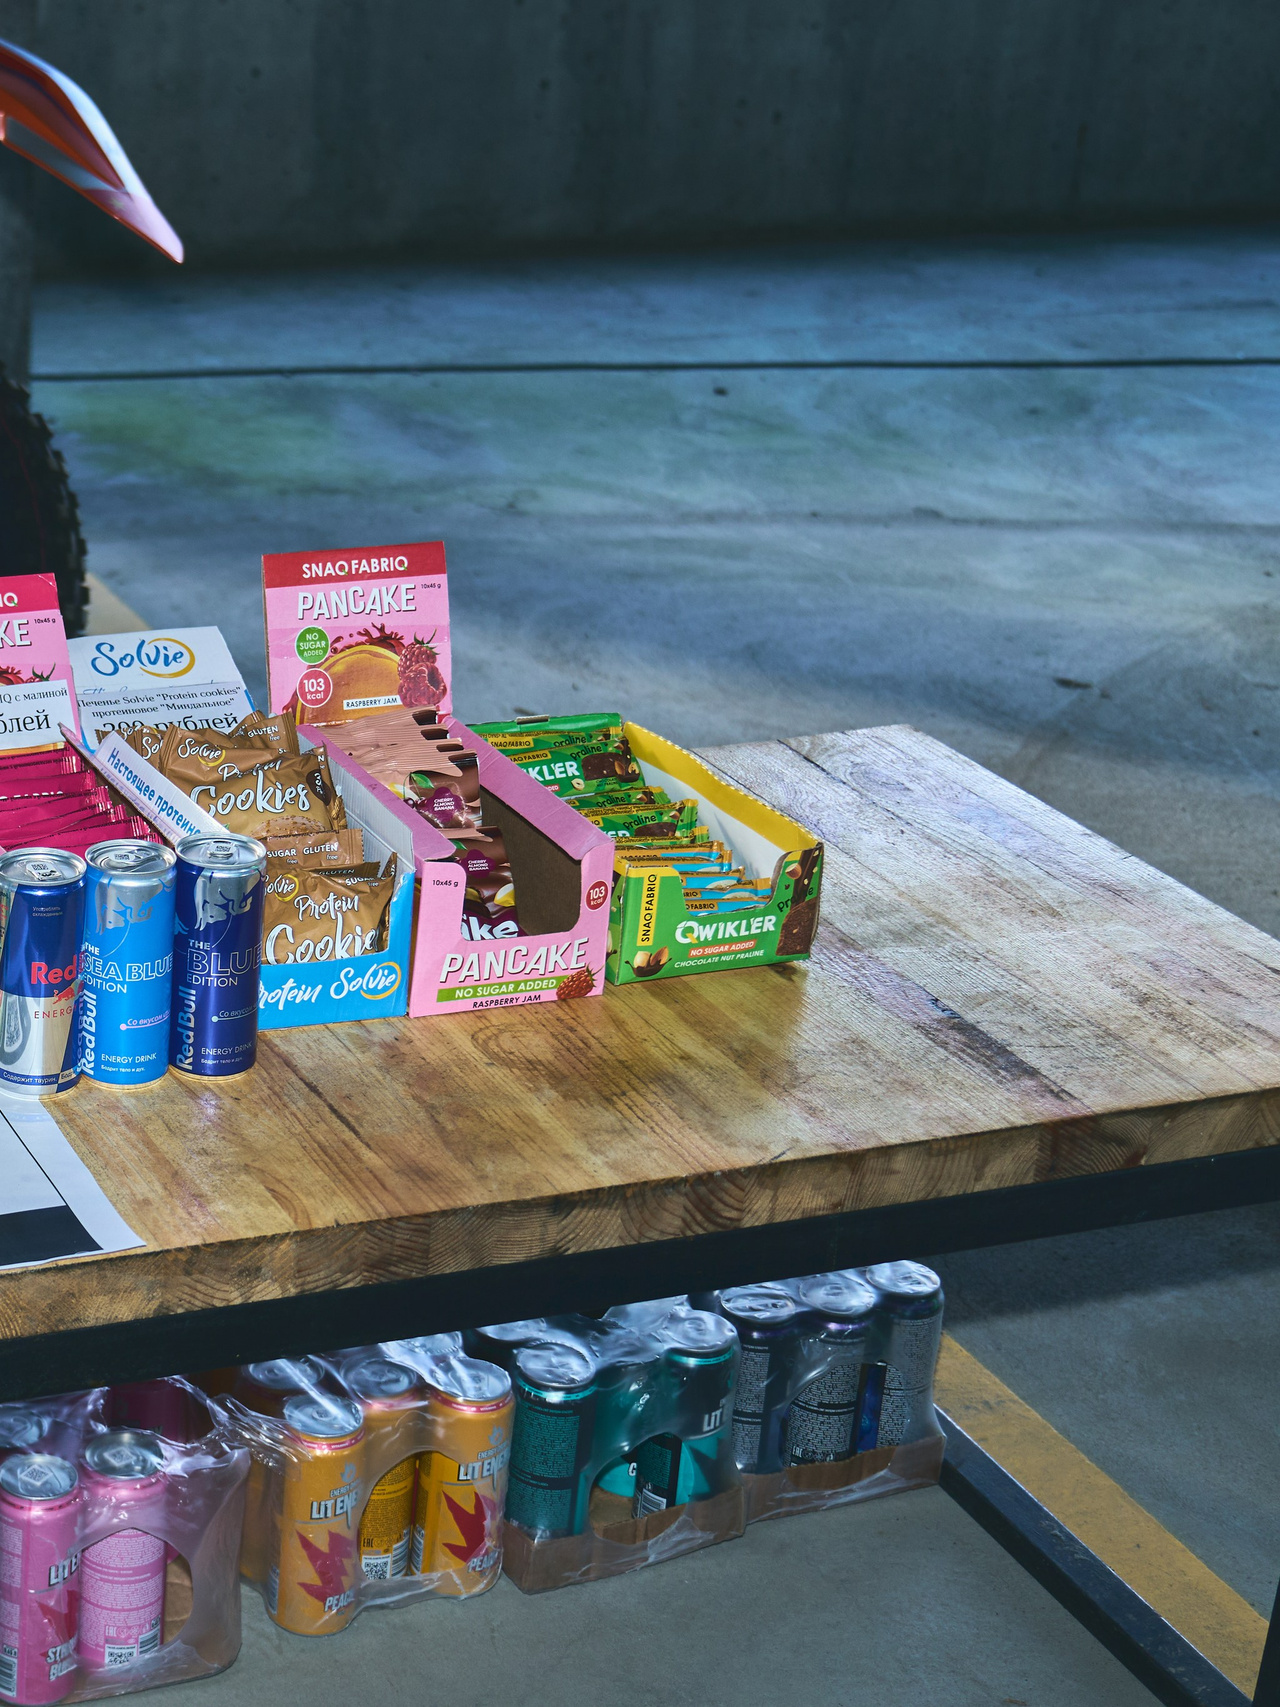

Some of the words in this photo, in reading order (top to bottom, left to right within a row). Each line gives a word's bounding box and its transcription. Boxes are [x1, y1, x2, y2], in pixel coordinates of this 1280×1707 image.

[302, 561, 349, 579] SNAQ
[351, 556, 408, 575] FABRIQ
[297, 584, 417, 620] PANCAKE
[299, 640, 326, 650] SUGAR
[306, 633, 318, 641] NO
[90, 639, 184, 676] Solvie
[303, 679, 325, 692] 103
[23, 688, 68, 701] малиной
[122, 695, 155, 705] Solvie
[306, 691, 324, 700] kcal
[346, 699, 382, 708] RASPBERRY
[383, 697, 398, 705] JAM
[92, 706, 159, 718] протеиновое
[247, 725, 278, 738] GLUTEN
[107, 747, 156, 801] Настоящее
[190, 768, 311, 817] Cookies
[266, 849, 297, 858] SUGAR
[303, 842, 339, 855] GLUTEN
[589, 886, 606, 900] 103
[294, 892, 359, 921] Protein
[675, 915, 776, 944] QWIKLER
[84, 942, 99, 956] THE
[188, 939, 210, 950] THE
[690, 948, 703, 956] NO
[704, 945, 729, 955] SUGAR
[730, 941, 755, 951] ADDED
[83, 953, 123, 980] SEA
[126, 951, 173, 982] BLUE
[187, 942, 262, 976] BLUE
[439, 937, 588, 983] PANCAKE
[674, 957, 719, 968] CHOCOLATE
[736, 950, 764, 961] PRALINE
[31, 955, 77, 985] Red
[83, 975, 127, 993] EDITION
[187, 973, 238, 988] EDITION
[455, 988, 473, 998] NO
[476, 984, 514, 996] SUGAR
[517, 979, 556, 990] ADDED
[178, 986, 196, 1027] Bull
[472, 996, 520, 1009] RASPBERRY
[522, 994, 541, 1004] JAM
[84, 989, 97, 1032] Bull
[82, 1031, 95, 1075] Red
[176, 1027, 194, 1070] Red
[202, 1047, 233, 1055] ENERGY
[234, 1041, 253, 1053] DRINK
[101, 1054, 133, 1063] ENERGY
[135, 1053, 157, 1063] DRINK
